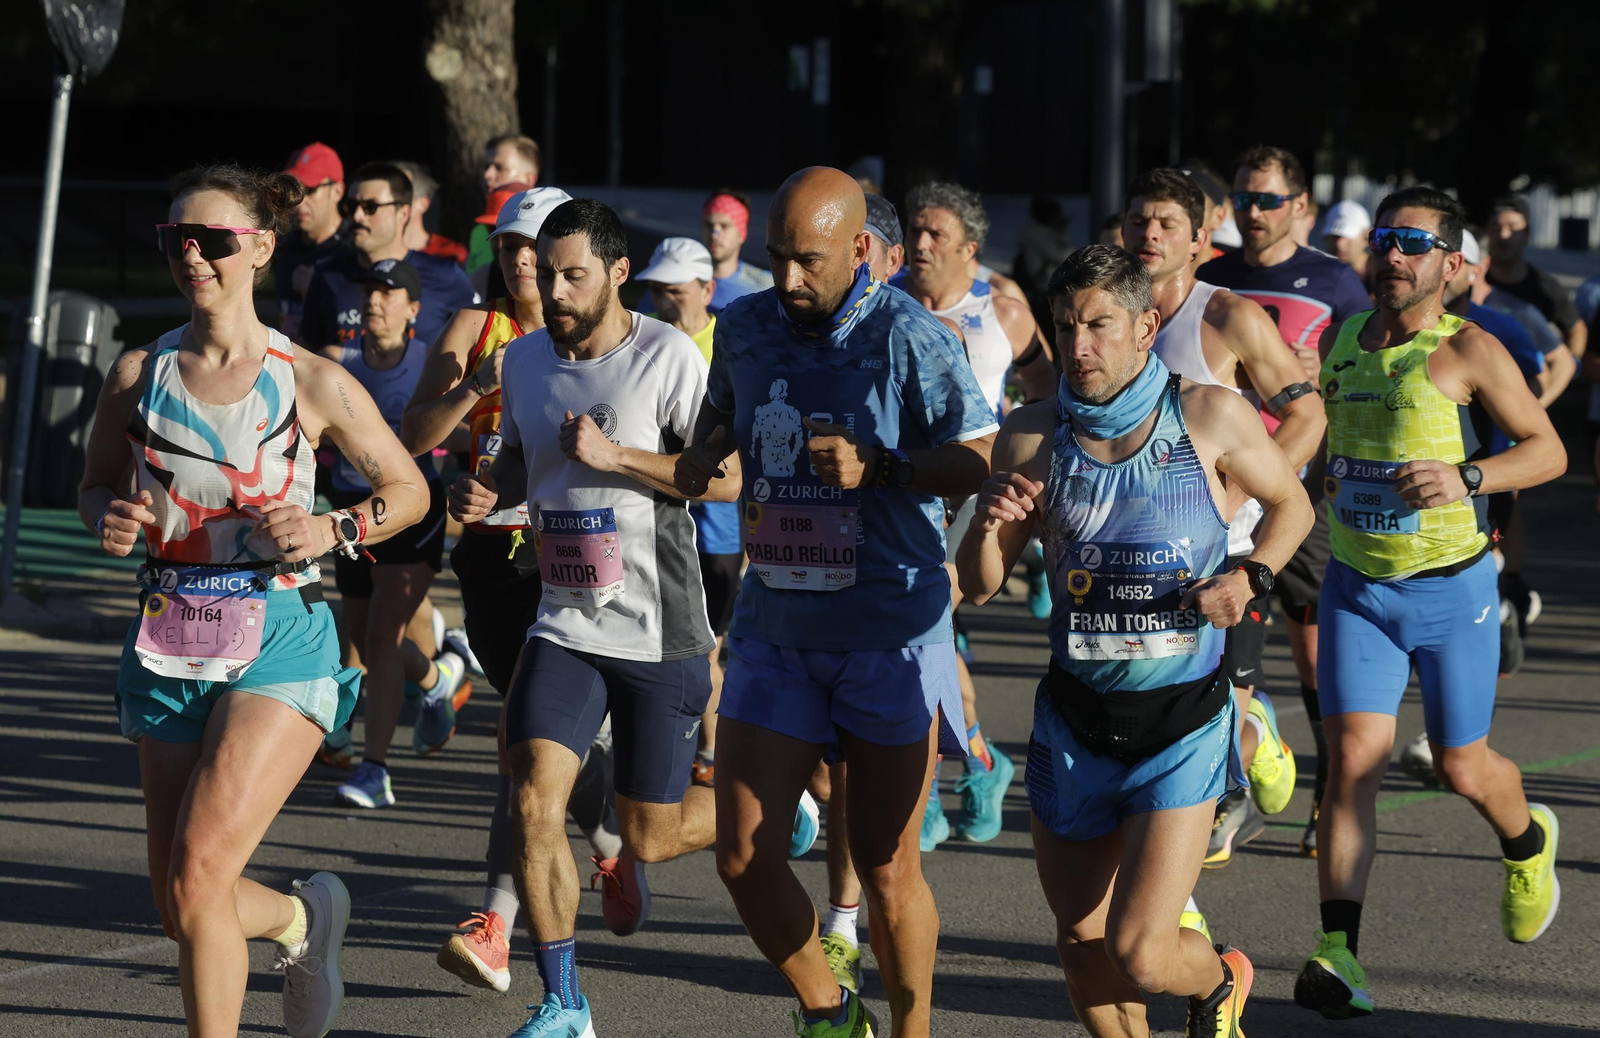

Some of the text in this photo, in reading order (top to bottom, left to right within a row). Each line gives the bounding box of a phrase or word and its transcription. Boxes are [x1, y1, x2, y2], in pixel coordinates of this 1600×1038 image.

[777, 485, 842, 500] ZURICH
[1353, 492, 1382, 507] 6389
[549, 516, 603, 529] ZURICH
[780, 517, 813, 532] 8188
[555, 545, 582, 558] 8686
[745, 542, 854, 565] PABLO REÍLLO
[1109, 549, 1178, 566] ZURICH
[550, 563, 599, 583] AITOR
[184, 575, 252, 592] ZURICH
[1107, 584, 1154, 600] 14552
[180, 606, 222, 623] 10164
[1070, 608, 1197, 632] FRAN TORRES
